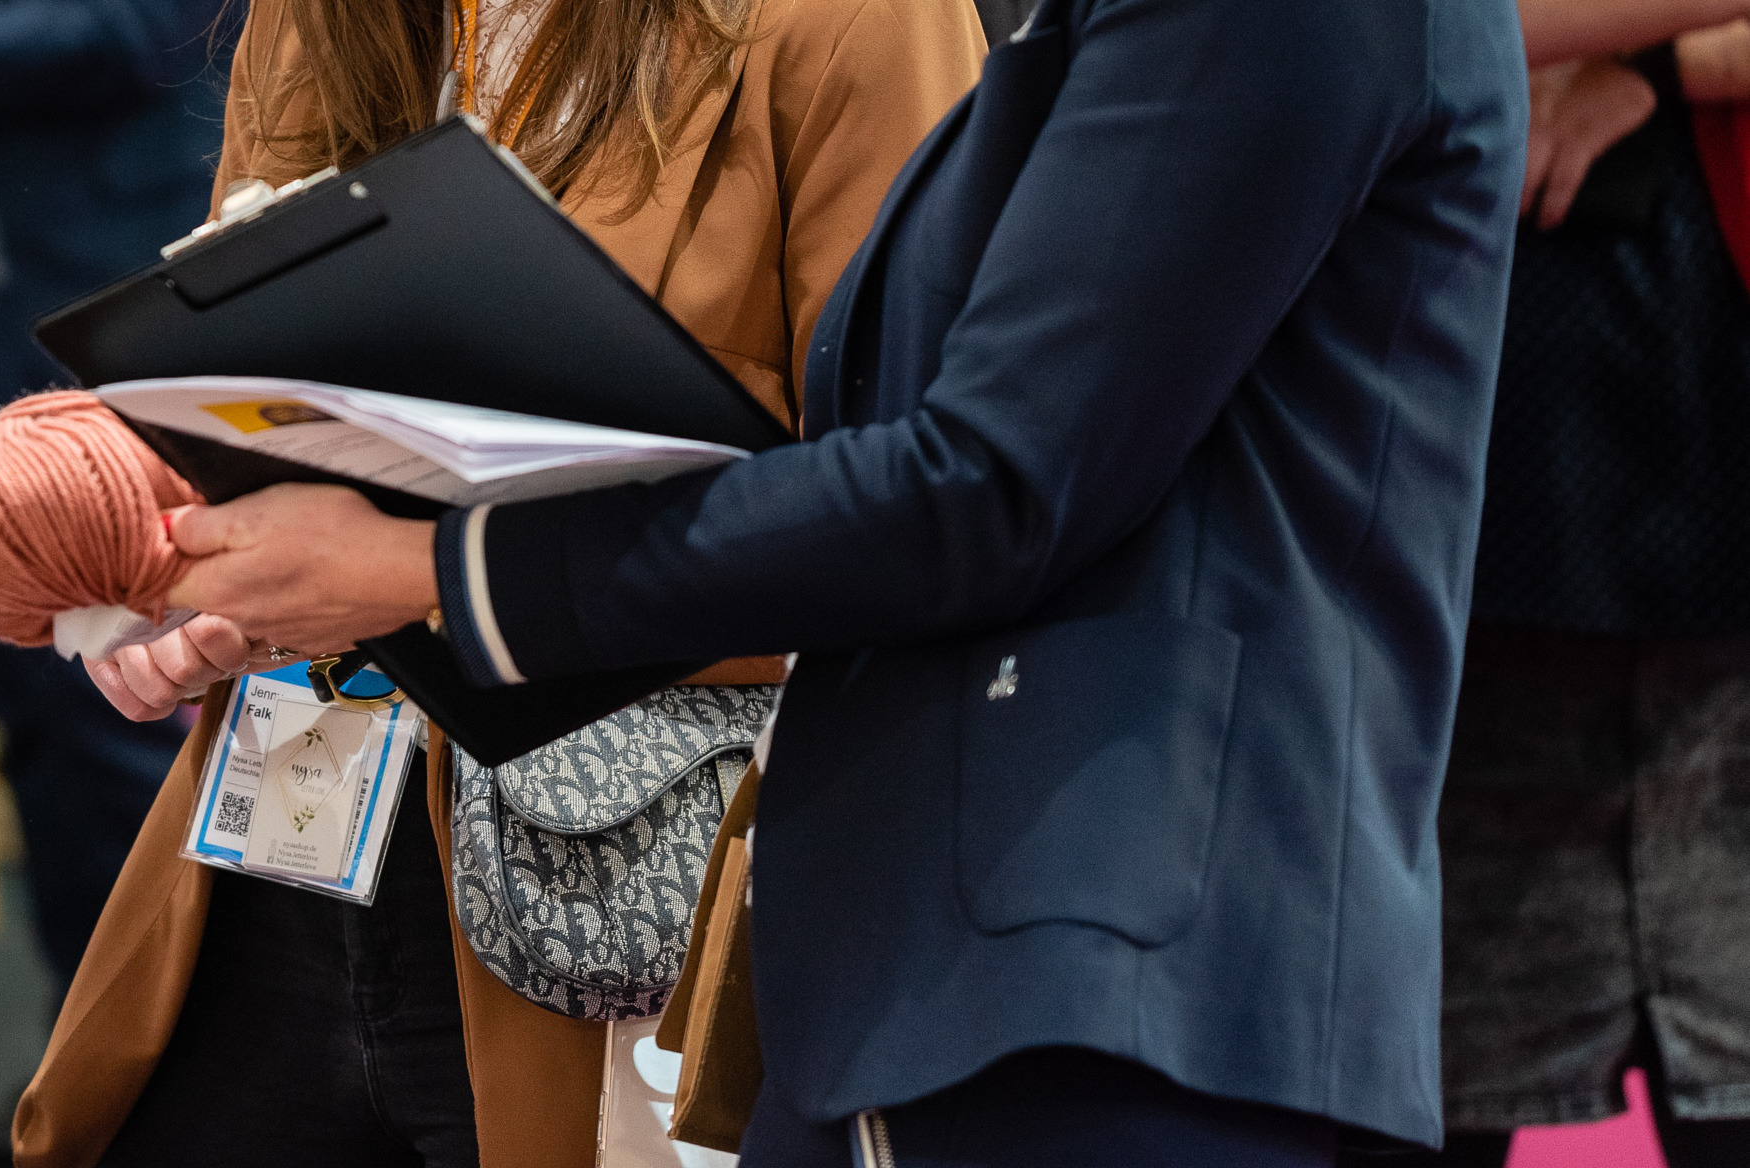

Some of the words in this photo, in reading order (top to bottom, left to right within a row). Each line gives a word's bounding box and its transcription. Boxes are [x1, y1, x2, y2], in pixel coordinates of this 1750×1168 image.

[251, 685, 283, 700] Jenn
[246, 704, 272, 720] Falk
[232, 754, 248, 765] Nysa
[230, 765, 260, 777] Deutschla
[291, 762, 322, 786] nysa
